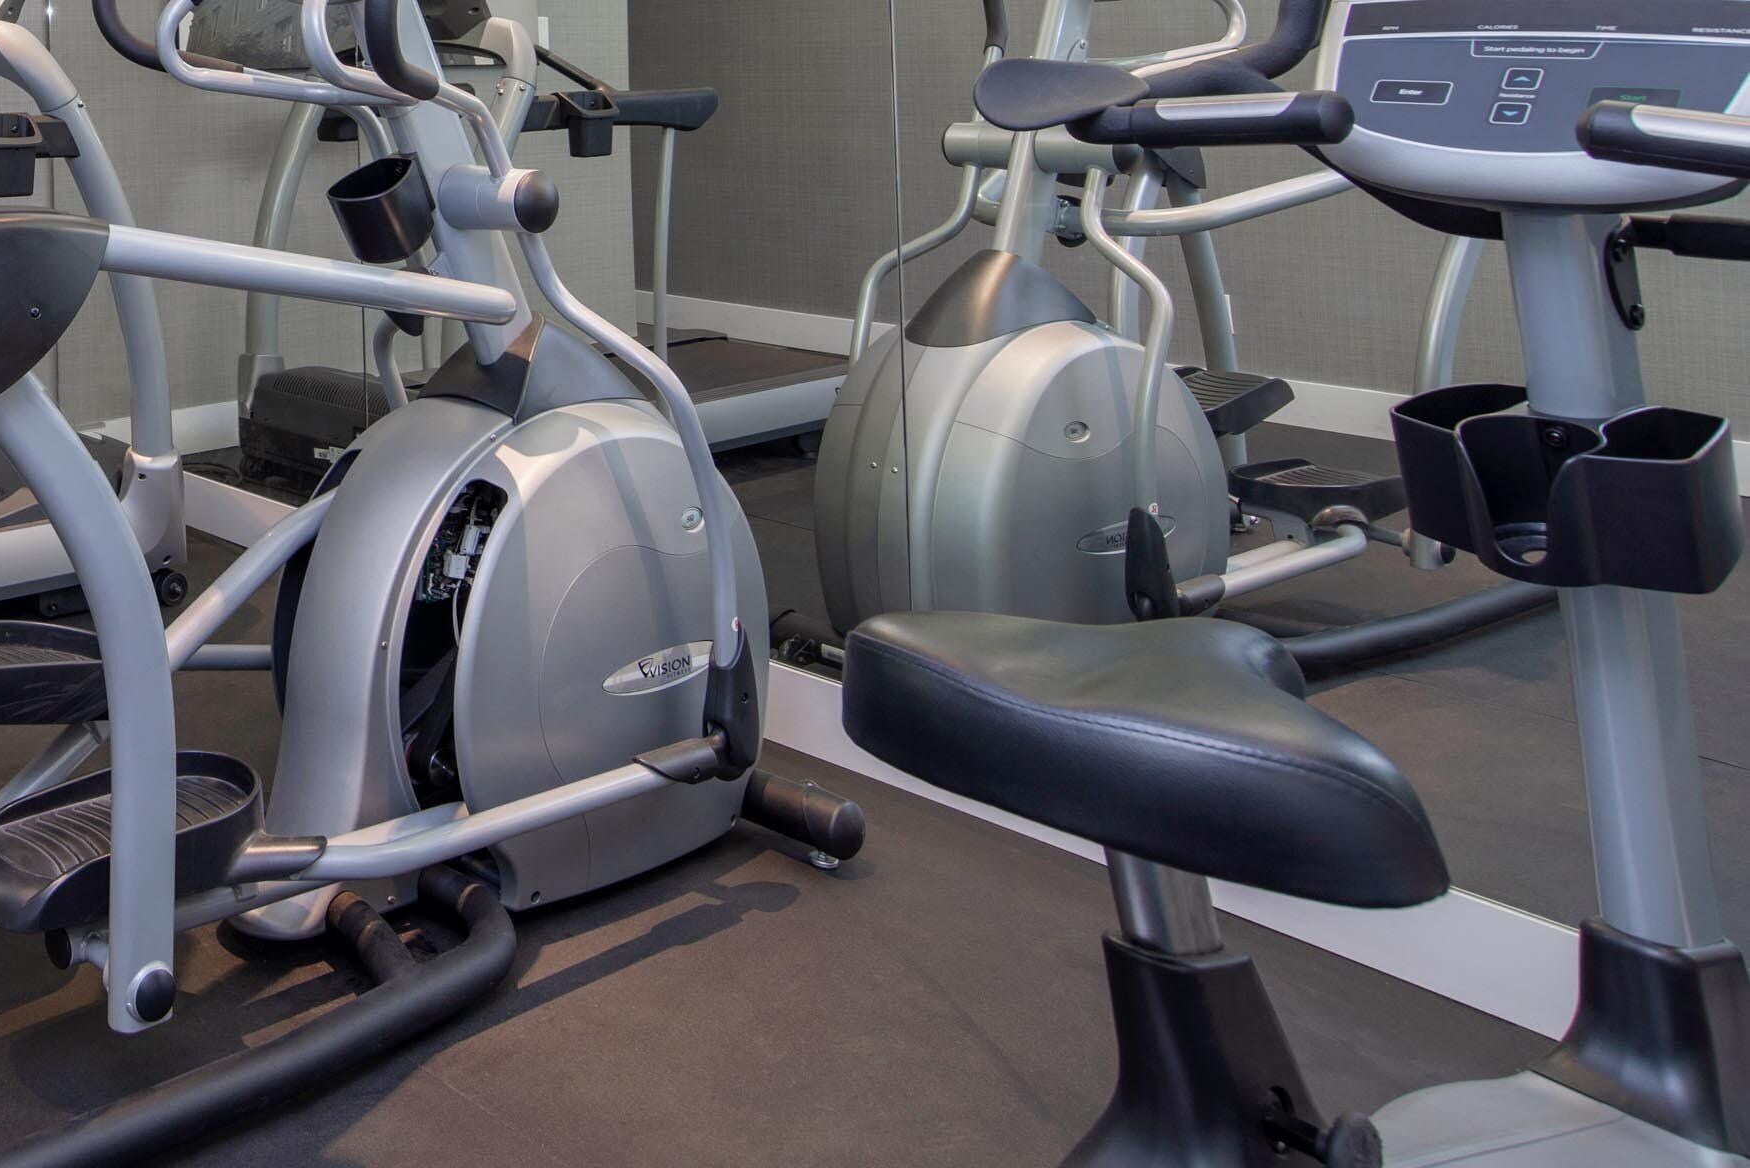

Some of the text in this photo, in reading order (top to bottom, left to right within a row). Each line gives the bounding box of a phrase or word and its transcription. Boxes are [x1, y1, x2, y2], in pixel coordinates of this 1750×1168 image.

[1505, 46, 1546, 54] pedaling
[1399, 88, 1423, 96] Enter
[1620, 94, 1648, 102] Start
[650, 655, 690, 678] VISION
